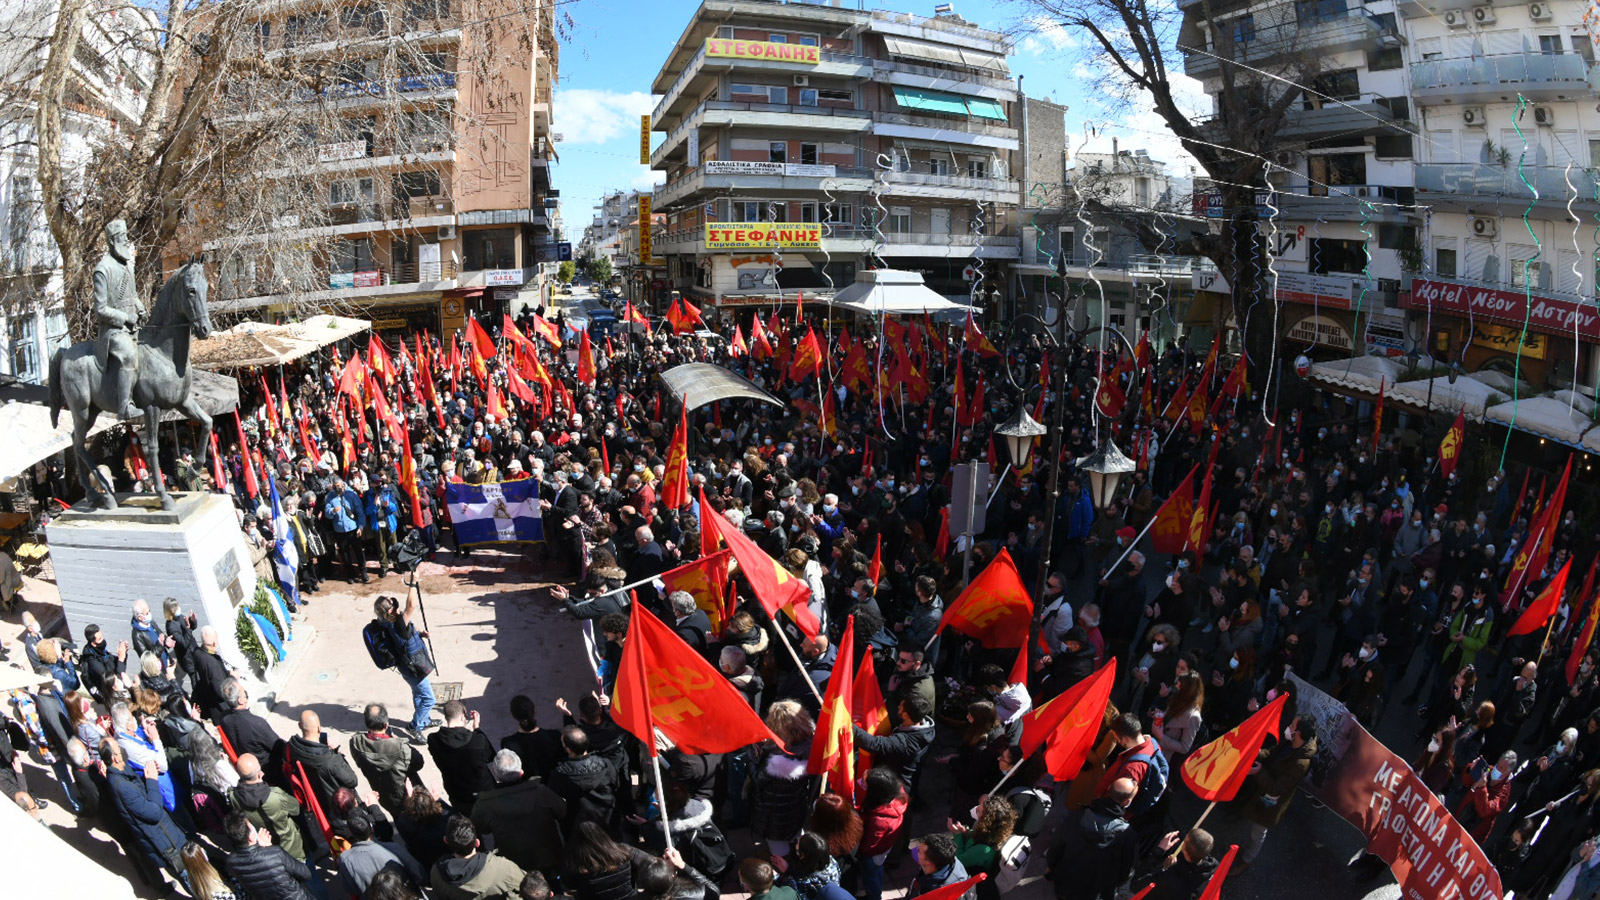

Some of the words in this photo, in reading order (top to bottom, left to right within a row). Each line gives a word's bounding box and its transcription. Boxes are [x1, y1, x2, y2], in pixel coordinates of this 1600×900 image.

[709, 40, 817, 61] ΣΤΕΦΑΝΗΣ
[641, 197, 650, 261] ΣΤΕΦΑΝΗΣ
[709, 230, 819, 242] ΣΤΕΦΑΝΗΣ
[559, 245, 571, 259] P
[1416, 284, 1461, 304] Hotel
[1373, 761, 1402, 795] ΜΕ
[1397, 784, 1448, 848] ΑΓΩΝΑ
[1445, 838, 1476, 880] ΚΑΙ
[1369, 791, 1433, 873] ΓΡΑΦΕΤΑΙ
[1426, 862, 1447, 889] Η
